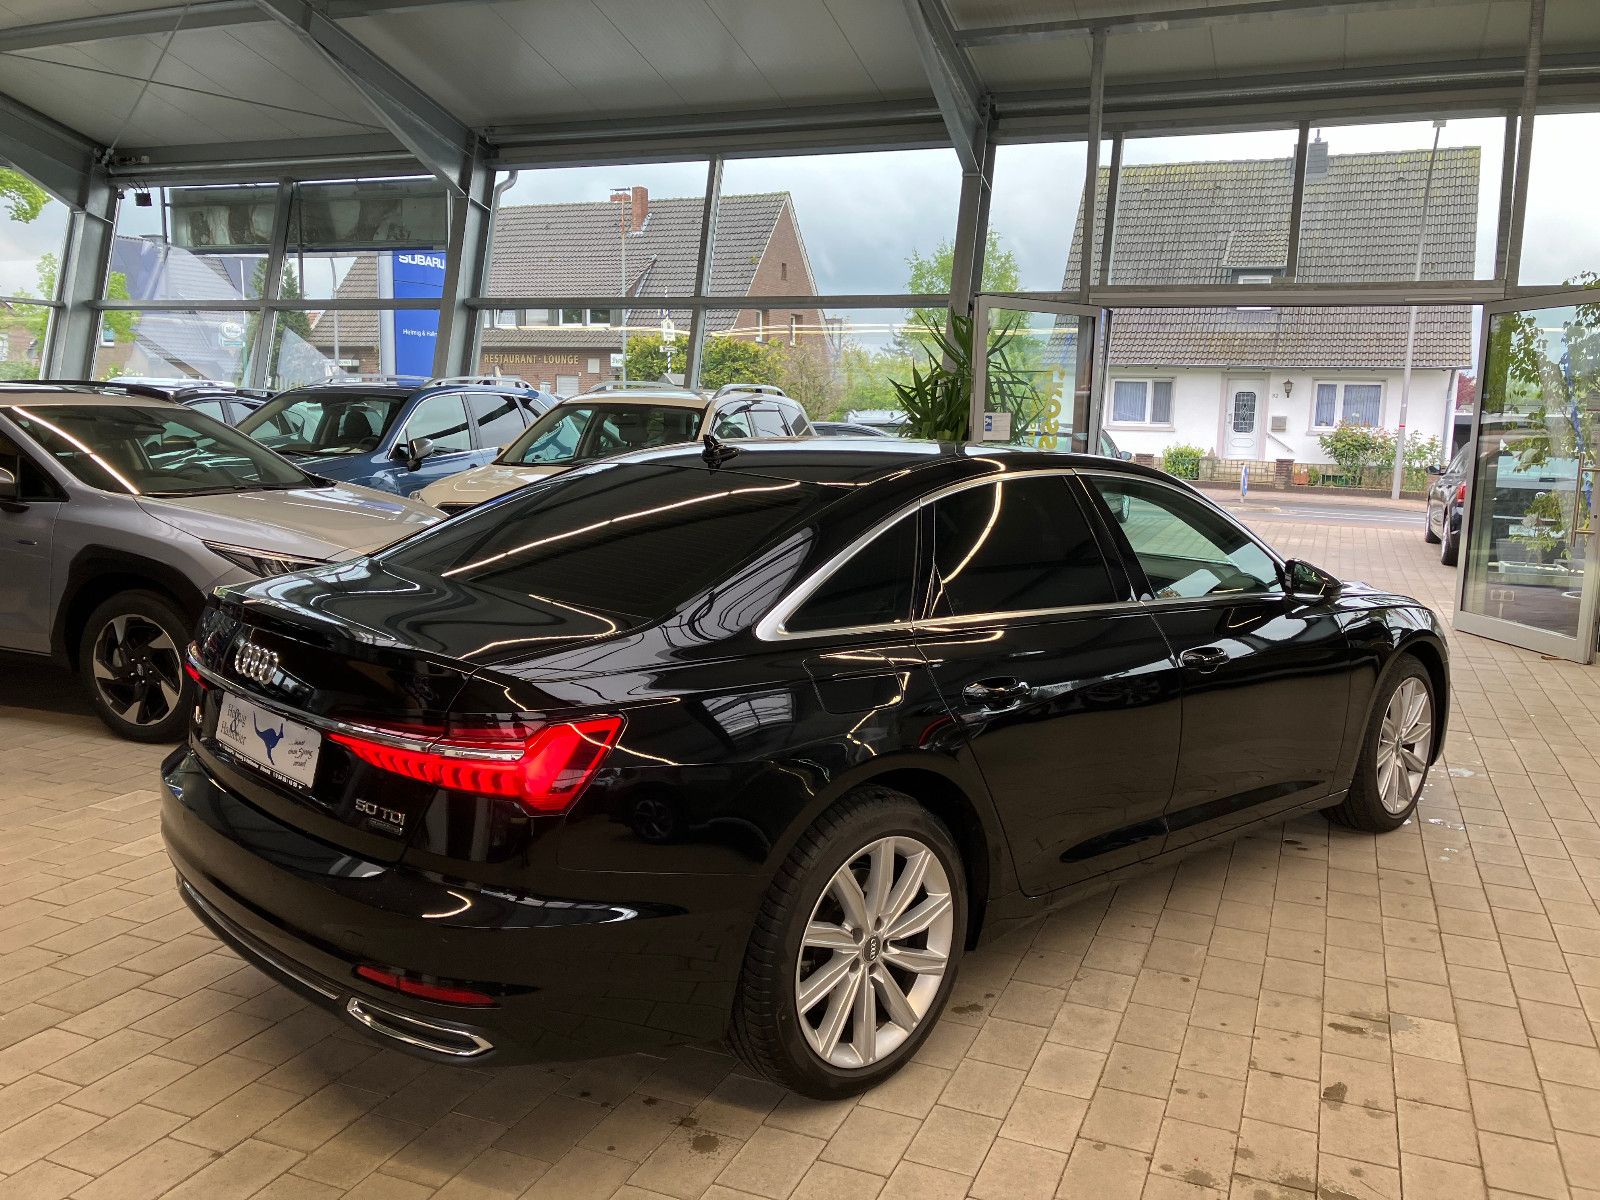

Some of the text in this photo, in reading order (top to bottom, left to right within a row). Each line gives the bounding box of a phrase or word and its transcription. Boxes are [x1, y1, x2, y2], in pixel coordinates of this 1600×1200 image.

[398, 254, 445, 270] SUBARU
[484, 353, 579, 365] RESTAURANT LOUNGE
[355, 798, 406, 826] 50 TDI
